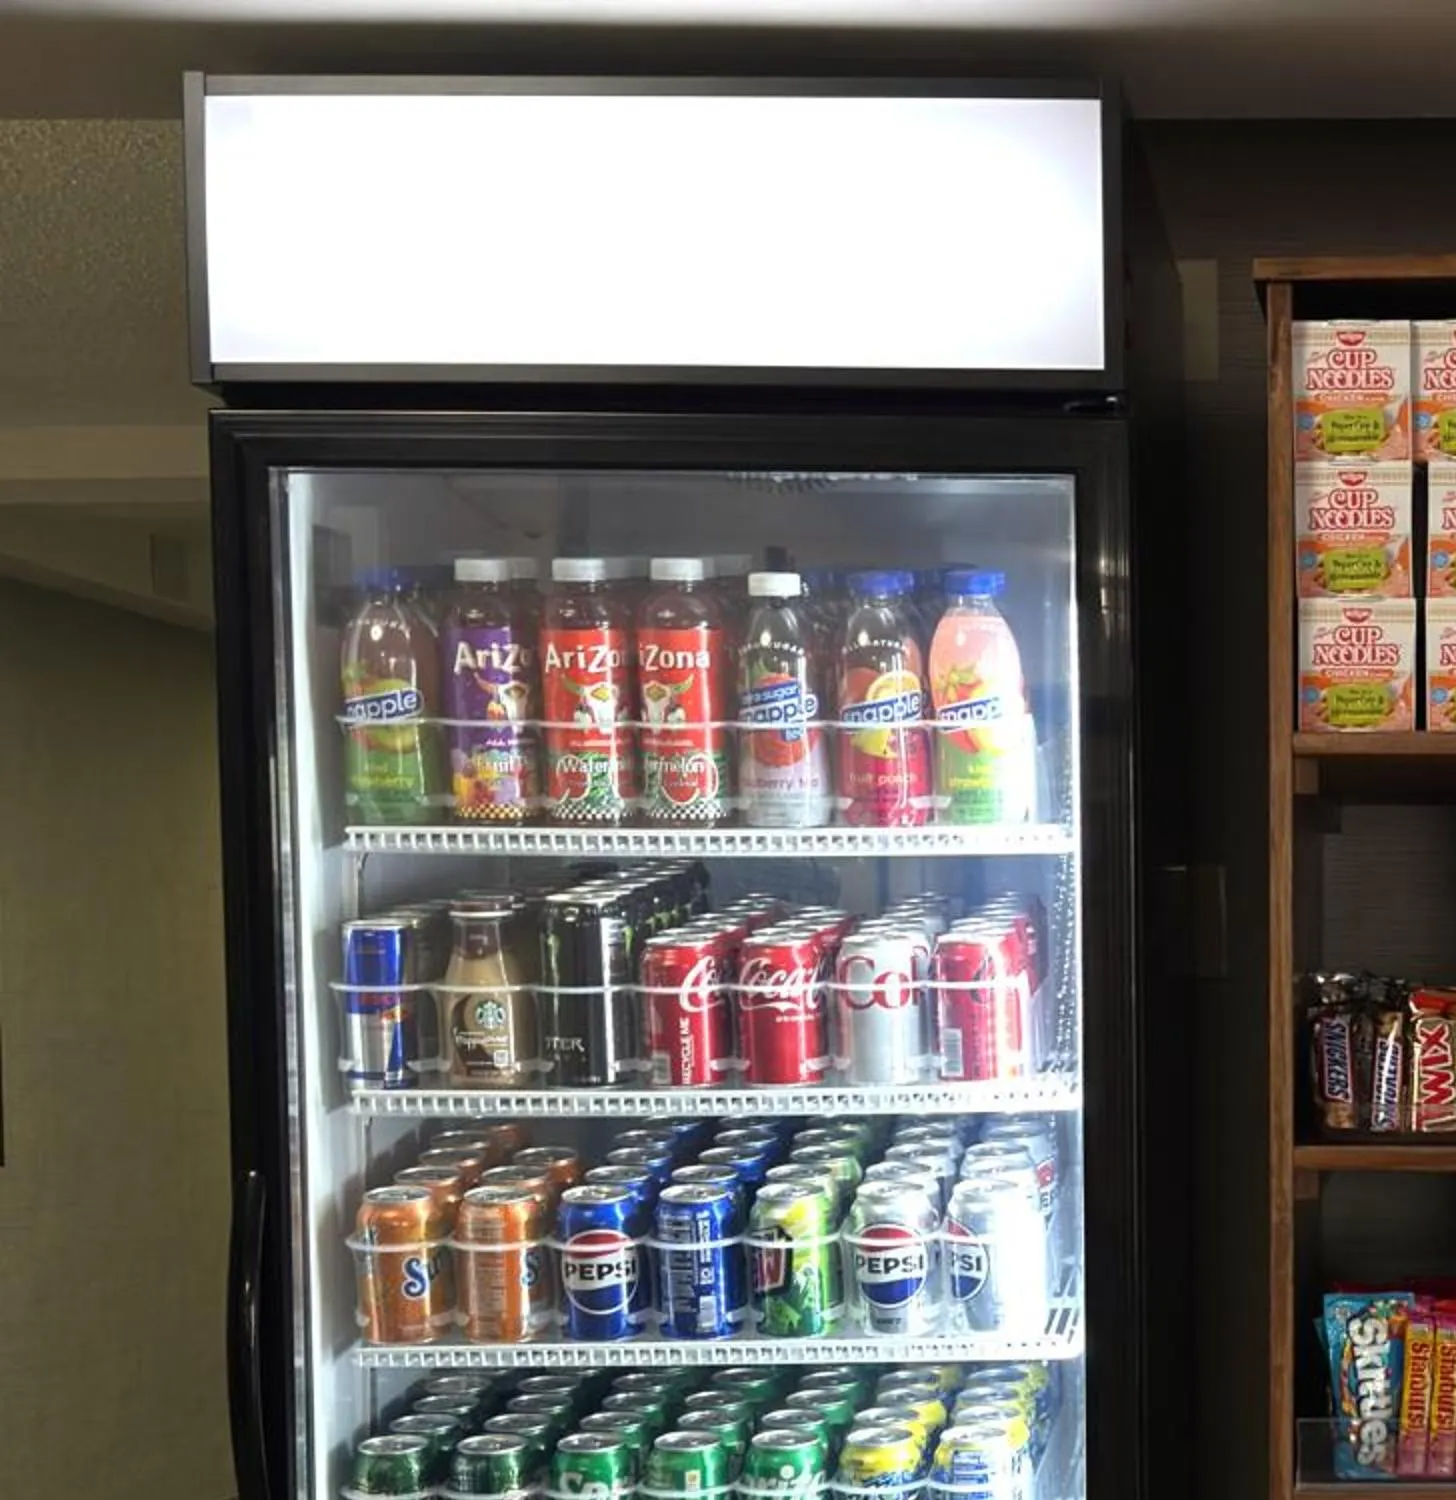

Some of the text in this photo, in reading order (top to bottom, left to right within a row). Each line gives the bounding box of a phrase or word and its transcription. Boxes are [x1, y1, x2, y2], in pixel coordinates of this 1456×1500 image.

[1328, 349, 1377, 369] CUP
[1306, 367, 1394, 390] NOODLES
[1328, 488, 1378, 509] CUP
[1309, 506, 1395, 530] NOODLES
[1332, 625, 1382, 646] CUP
[453, 641, 528, 674] AriZ
[545, 641, 621, 674] AriZo
[639, 644, 710, 672] iZona
[1313, 643, 1400, 666] NOODLES
[1325, 1021, 1350, 1098] SNICKERS
[565, 1259, 637, 1281] PEPSI
[856, 1254, 925, 1276] PEPSI
[1348, 1316, 1393, 1465] Skittles
